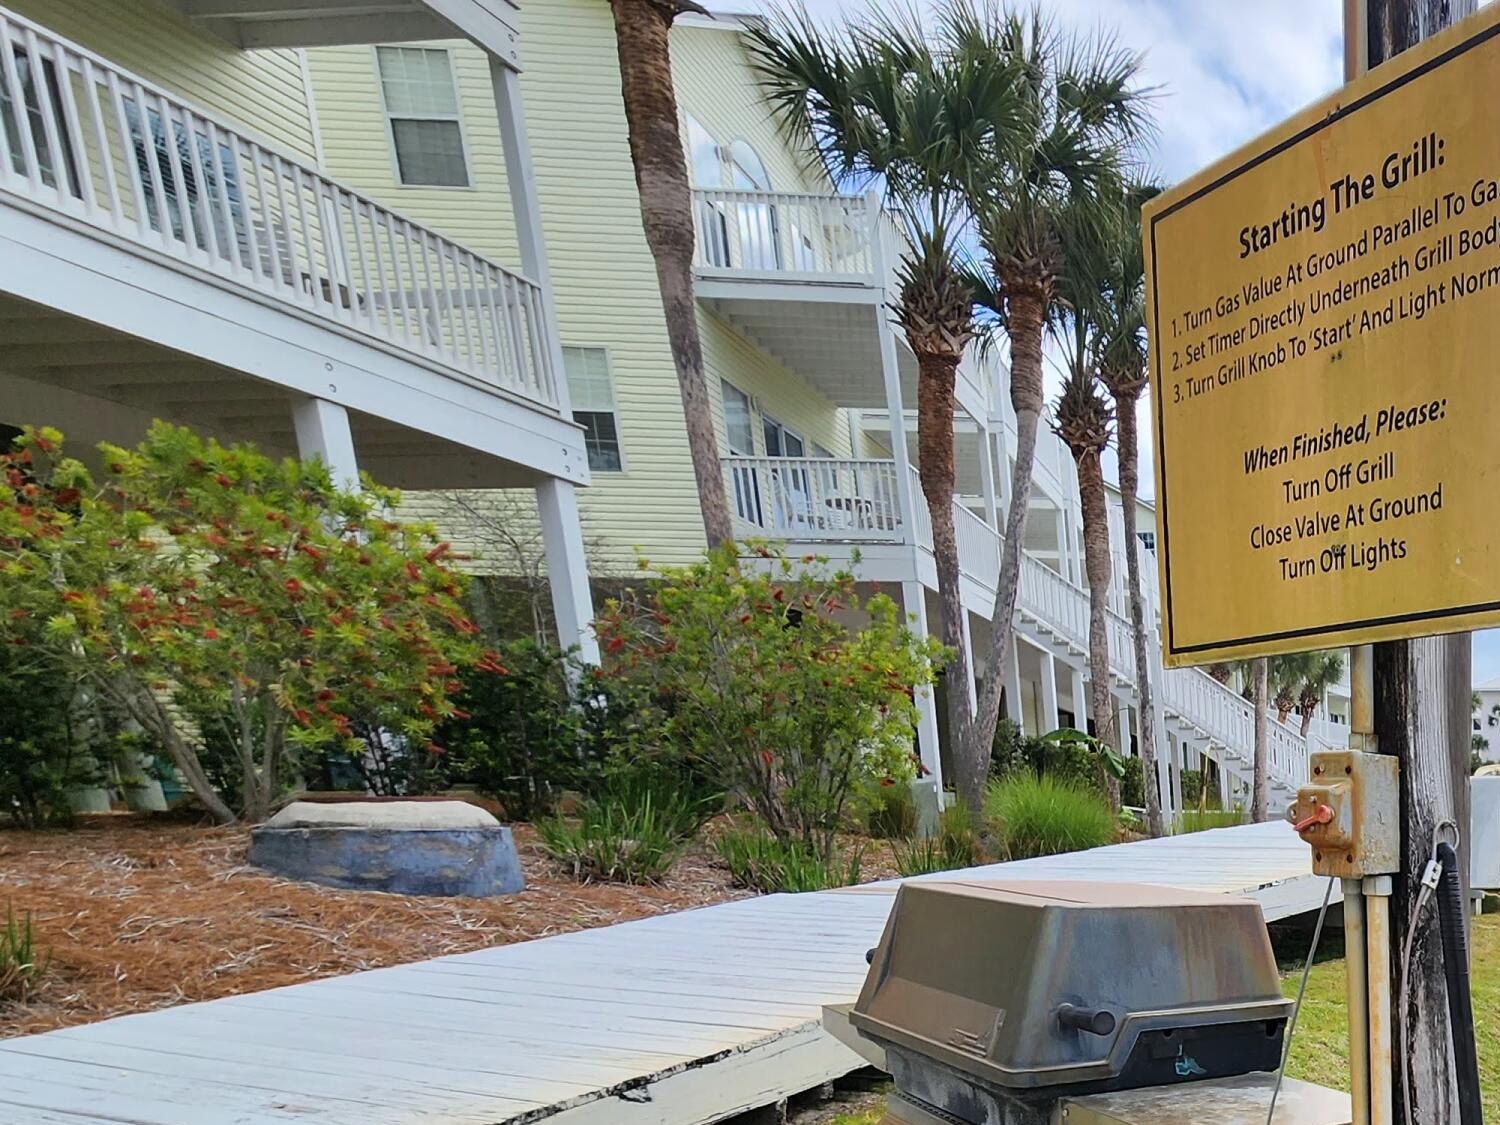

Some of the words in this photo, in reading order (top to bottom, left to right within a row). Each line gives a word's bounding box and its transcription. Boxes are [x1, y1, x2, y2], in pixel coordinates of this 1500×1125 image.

[1240, 197, 1325, 258] Starting
[1330, 174, 1374, 213] The
[1382, 132, 1444, 189] Grill:
[1172, 319, 1182, 338] 1.
[1184, 308, 1212, 331] Turn
[1216, 294, 1240, 317] Gas
[1243, 277, 1282, 306] Value
[1286, 262, 1302, 288] At
[1307, 230, 1367, 277] Ground
[1373, 198, 1438, 250] Parallel
[1443, 192, 1465, 219] To
[1172, 352, 1183, 371] 2.
[1186, 341, 1205, 365] Set
[1208, 327, 1246, 355] Timer
[1250, 300, 1305, 339] Directly
[1310, 255, 1409, 314] Underneath
[1415, 235, 1452, 271] Grill
[1174, 384, 1184, 403] 3.
[1186, 375, 1214, 398] Turn
[1218, 357, 1244, 386] Grill
[1249, 343, 1286, 375] Knob
[1289, 337, 1306, 359] To
[1360, 299, 1393, 334] And
[1399, 282, 1445, 319] Light
[1244, 445, 1288, 474] When
[1292, 414, 1371, 460] Finished,
[1376, 399, 1447, 437] Please:
[1283, 478, 1320, 504] Turn
[1325, 463, 1352, 492] Off
[1356, 452, 1393, 484] Grill
[1251, 524, 1292, 549] Close
[1295, 511, 1340, 539] Valve
[1345, 504, 1364, 528] At
[1369, 482, 1442, 523] Ground
[1279, 555, 1315, 581] Turn
[1320, 544, 1347, 572] Off
[1351, 537, 1407, 571] Lights
